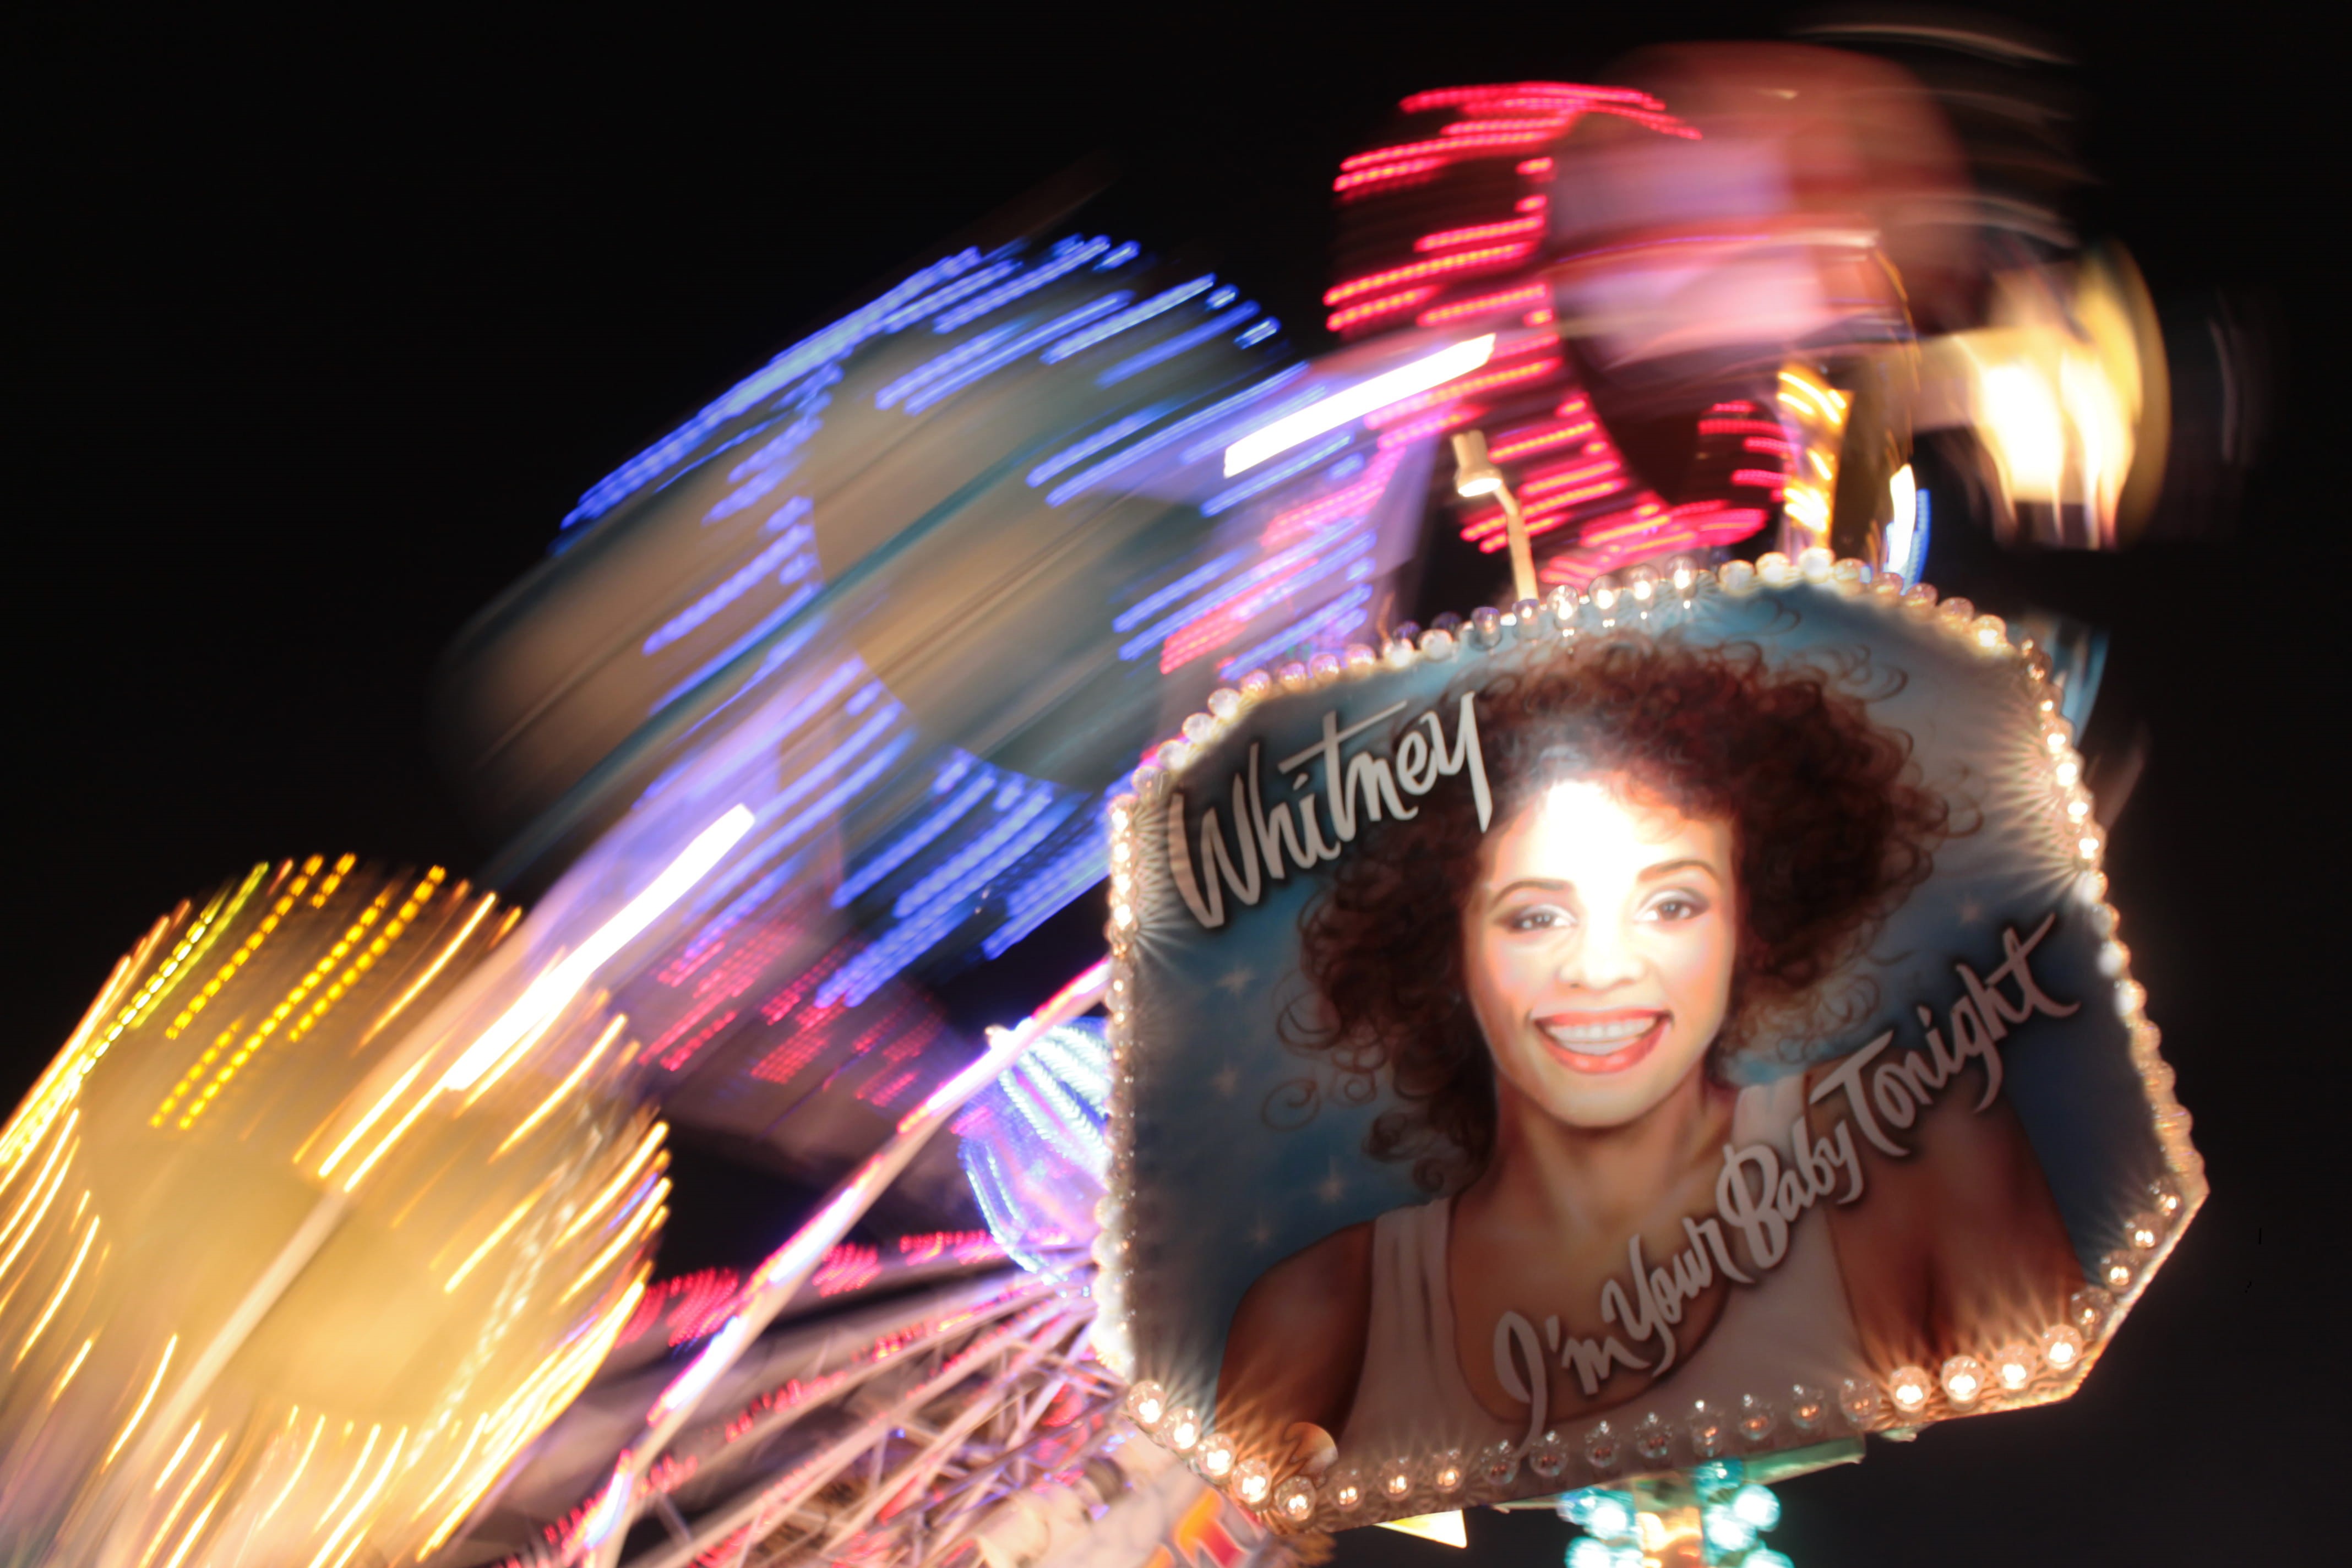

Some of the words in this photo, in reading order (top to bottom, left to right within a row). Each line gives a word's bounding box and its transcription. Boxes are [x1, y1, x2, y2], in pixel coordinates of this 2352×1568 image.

[1168, 692, 1493, 928] Whitney
[1493, 1311, 1651, 1460] I'm
[1601, 1217, 1755, 1376] Your
[1716, 1117, 1864, 1268] Baby
[1809, 913, 2081, 1156] Tonight
